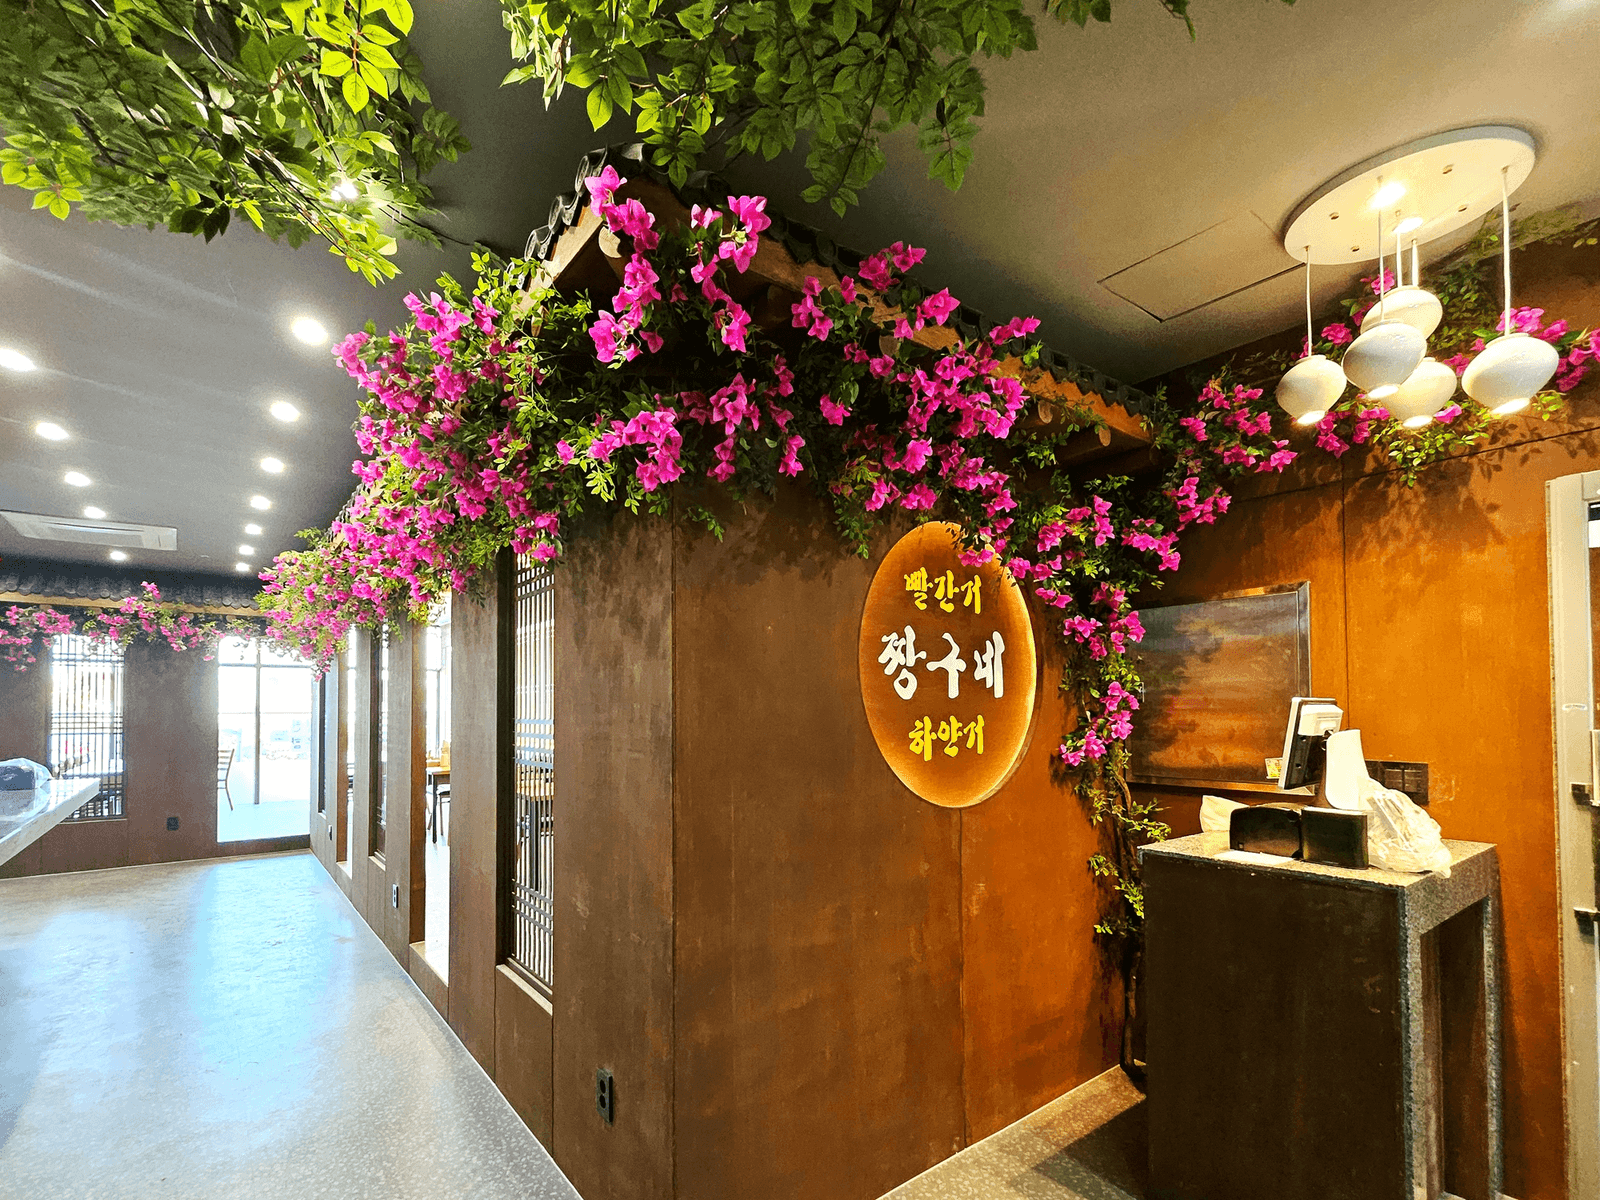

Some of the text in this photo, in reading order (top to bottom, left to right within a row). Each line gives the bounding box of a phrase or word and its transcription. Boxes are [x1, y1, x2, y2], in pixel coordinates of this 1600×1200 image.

[904, 567, 981, 614] 빨간거
[878, 625, 1005, 700] 짱구네
[908, 714, 985, 761] 하얀거
